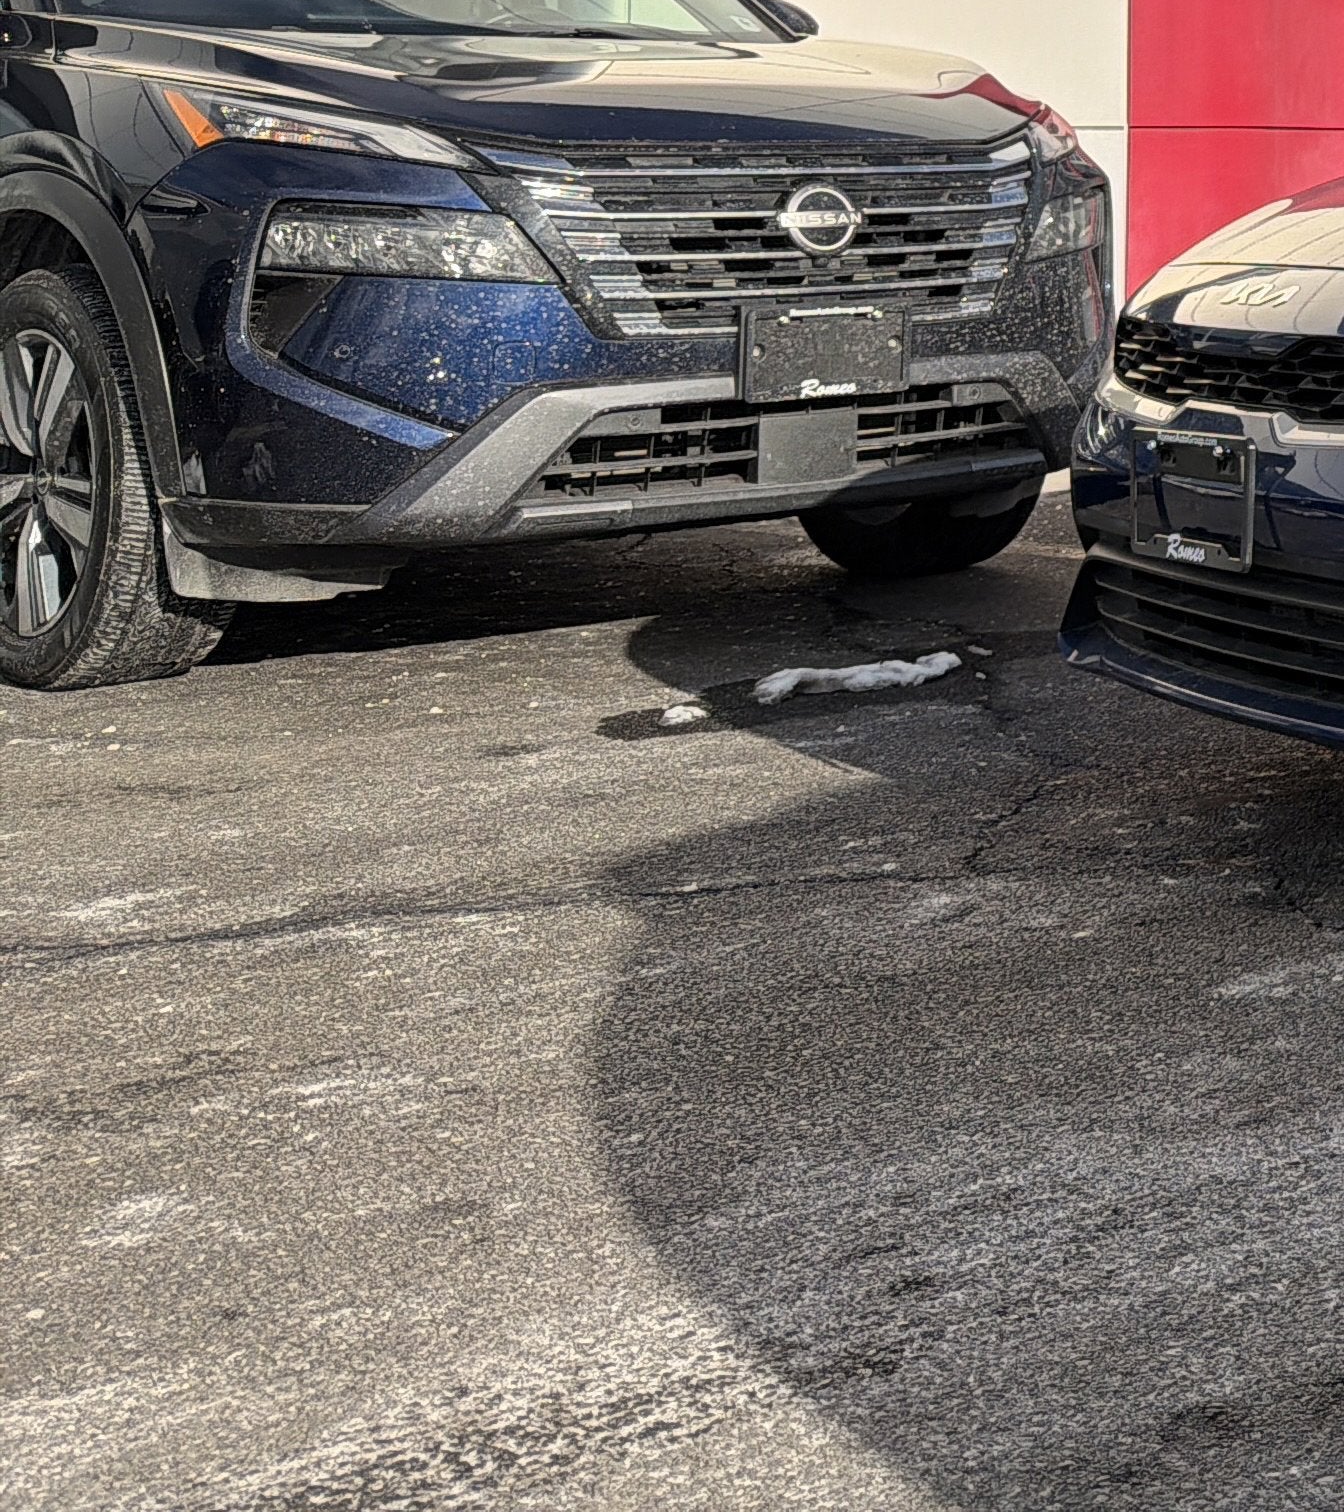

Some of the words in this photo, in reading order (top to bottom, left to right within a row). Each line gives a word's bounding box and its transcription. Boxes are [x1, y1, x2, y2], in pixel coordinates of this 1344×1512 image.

[782, 211, 863, 227] NISSAN
[800, 377, 857, 399] Romeo
[1165, 532, 1206, 563] Romeo
